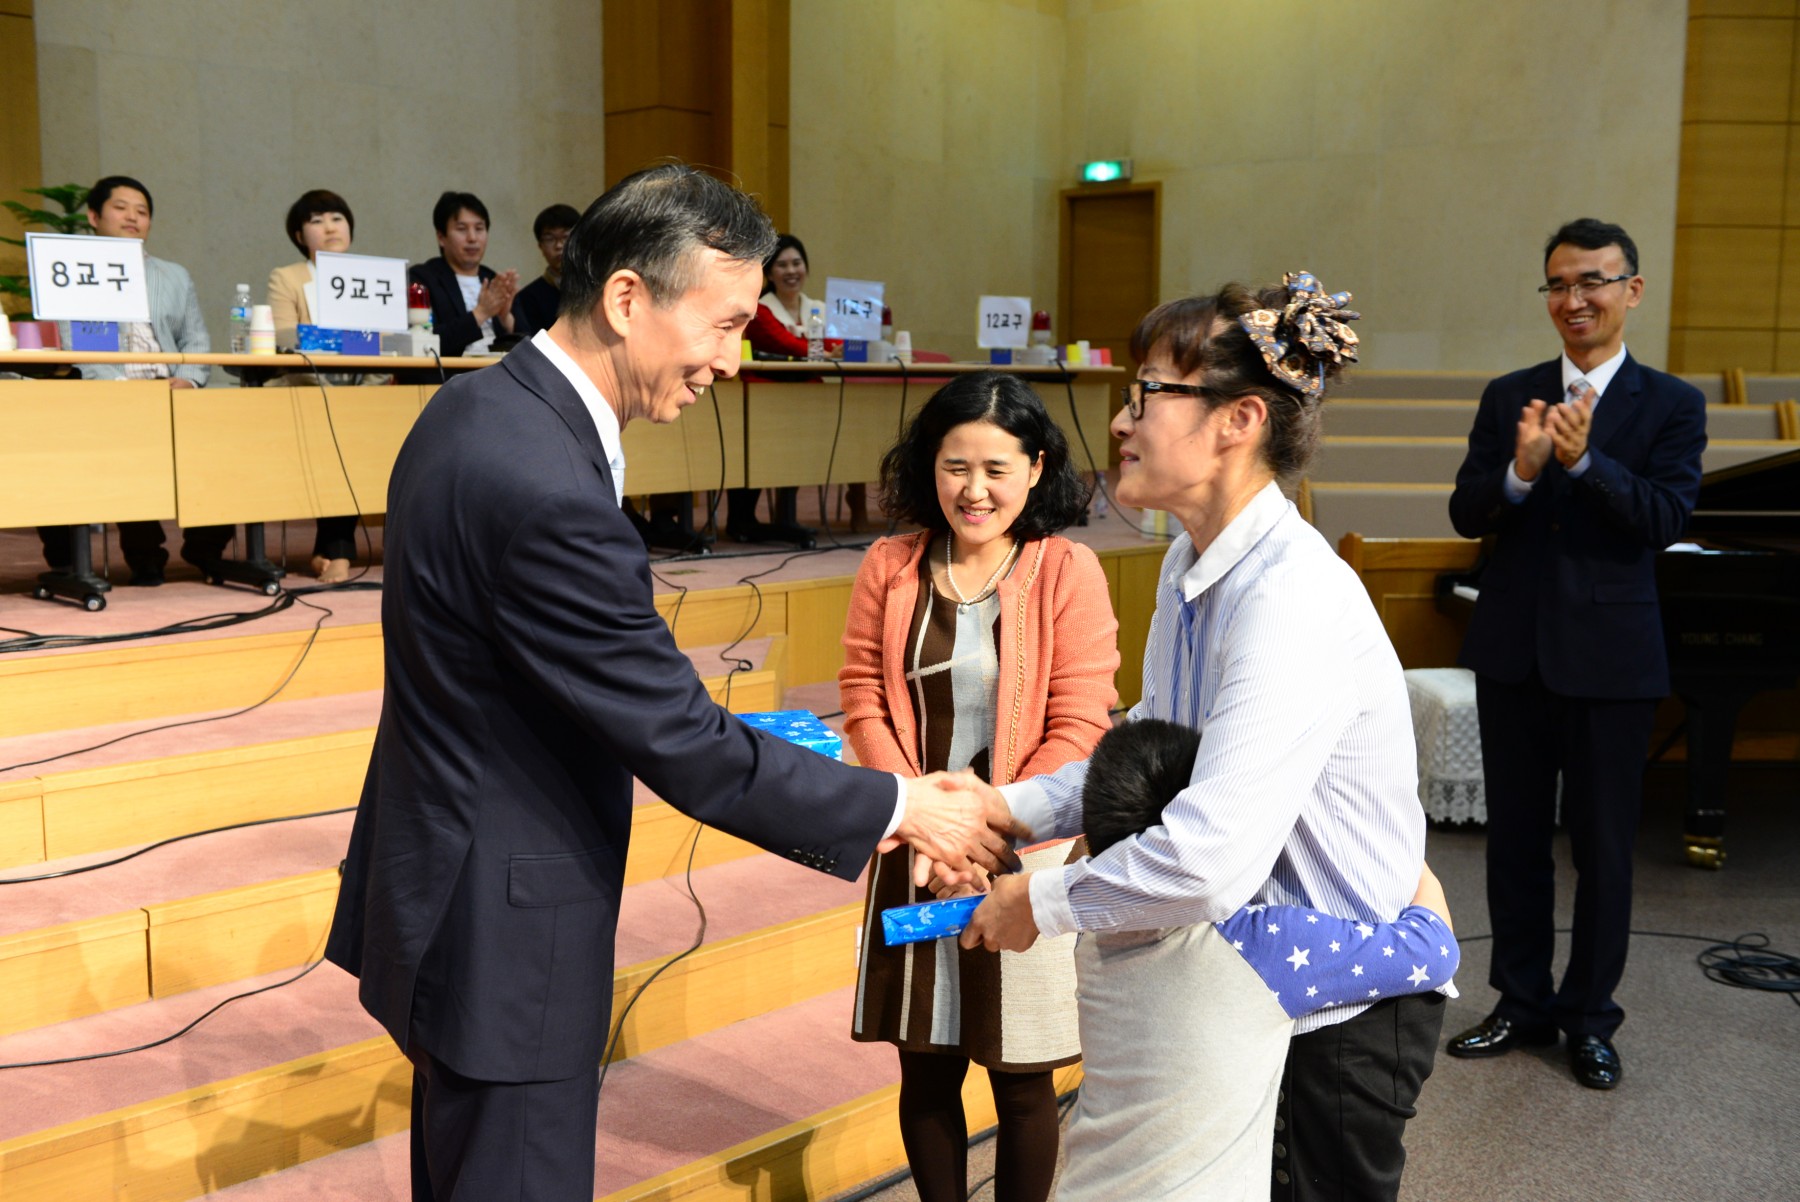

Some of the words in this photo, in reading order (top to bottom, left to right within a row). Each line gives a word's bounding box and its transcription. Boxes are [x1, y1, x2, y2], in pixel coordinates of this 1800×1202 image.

[52, 261, 130, 291] 8교구
[331, 276, 394, 305] 9교구
[985, 312, 1023, 330] 12교구
[1680, 631, 1719, 645] YOUNG
[1724, 631, 1763, 646] CHANG
